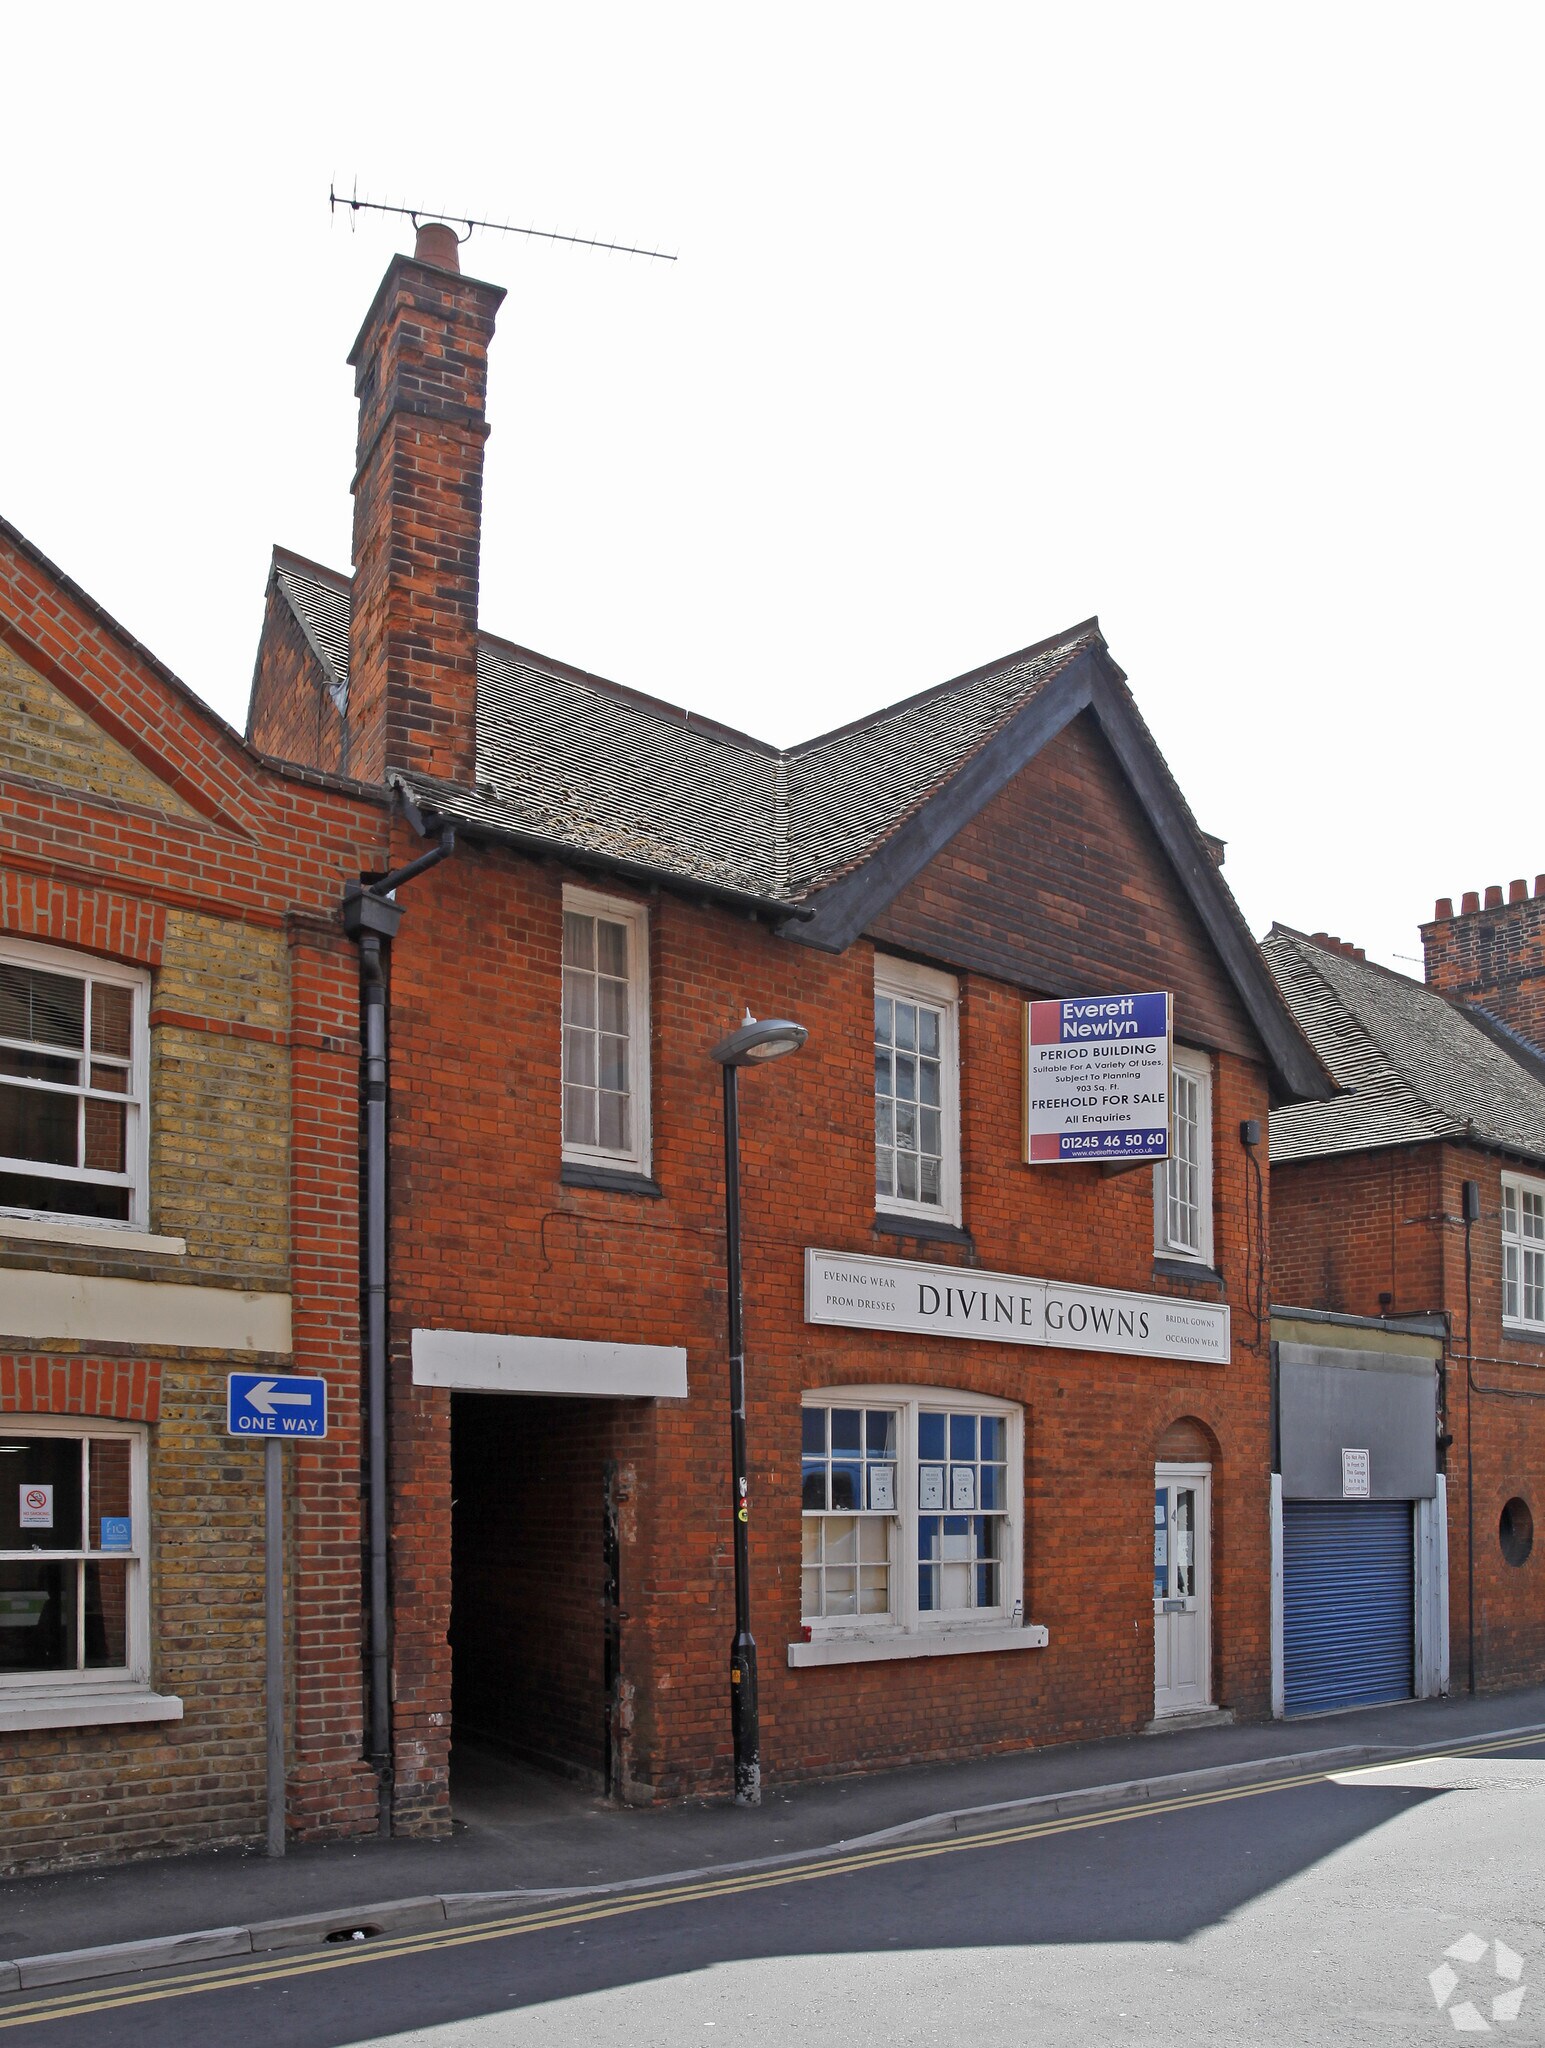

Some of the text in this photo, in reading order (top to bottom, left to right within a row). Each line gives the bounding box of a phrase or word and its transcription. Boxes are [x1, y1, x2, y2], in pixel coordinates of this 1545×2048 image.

[1063, 999, 1134, 1019] Everett
[1063, 1019, 1138, 1037] Newlyn
[1040, 1044, 1157, 1060] PERIOD BUILDING
[1033, 1064, 1067, 1074] Suitable
[1070, 1063, 1083, 1071] For
[1095, 1060, 1126, 1071] Variety
[1128, 1059, 1139, 1067] Of
[1055, 1071, 1141, 1083] Subject To Planning
[1094, 1084, 1107, 1092] Sq.
[1032, 1093, 1165, 1109] FREEHOLD FOR SALE
[1064, 1113, 1131, 1124] All Enquiries
[1061, 1133, 1164, 1149] 01245 46 50 60
[1071, 1148, 1153, 1157] www.everettnewlyn.co.uk
[824, 1271, 896, 1288] EVENING WEAR
[826, 1295, 896, 1312] PROM DRESSES
[917, 1283, 1149, 1338] DIVINE GOWNS
[1165, 1314, 1215, 1328] BRIDAL GOWNS
[1165, 1334, 1219, 1348] OCCASION WEAR
[238, 1416, 318, 1431] ONE WAY
[1171, 1509, 1177, 1522] 4
